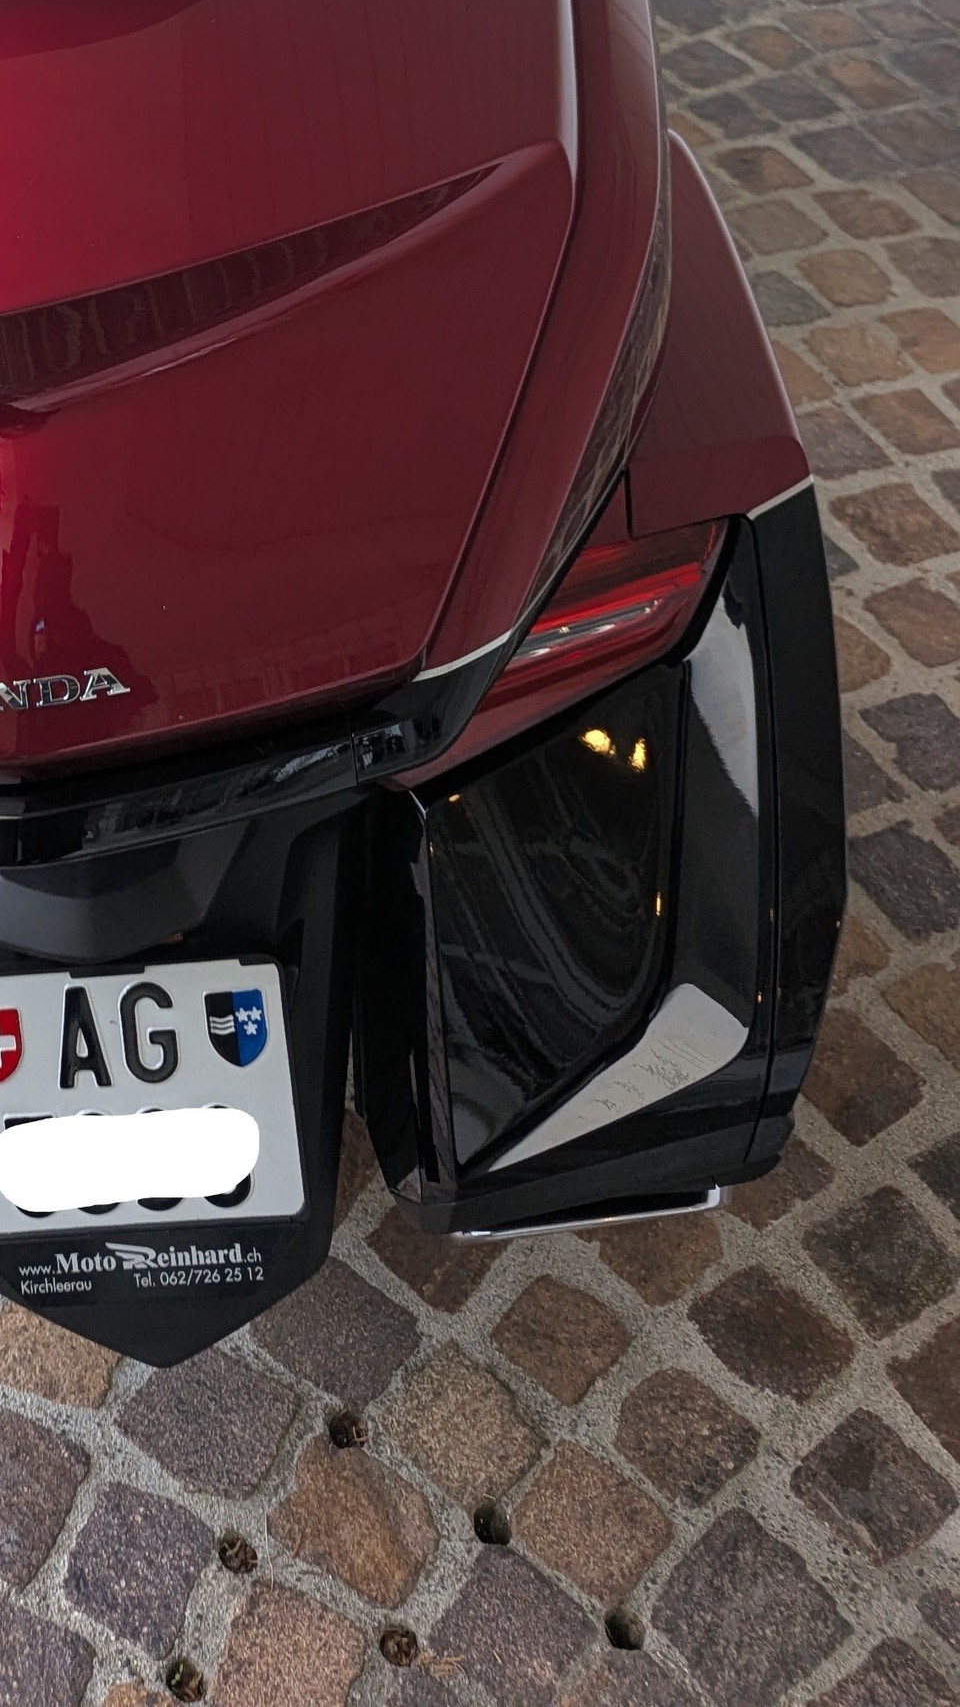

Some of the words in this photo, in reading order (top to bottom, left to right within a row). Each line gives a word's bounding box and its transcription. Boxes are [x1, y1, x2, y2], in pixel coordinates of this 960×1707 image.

[58, 981, 179, 1089] AG
[21, 1277, 92, 1295] Kirchleerau
[134, 1270, 156, 1288] Tel.
[160, 1268, 221, 1286] 062/726
[224, 1267, 242, 1283] 25
[247, 1266, 264, 1281] 12
